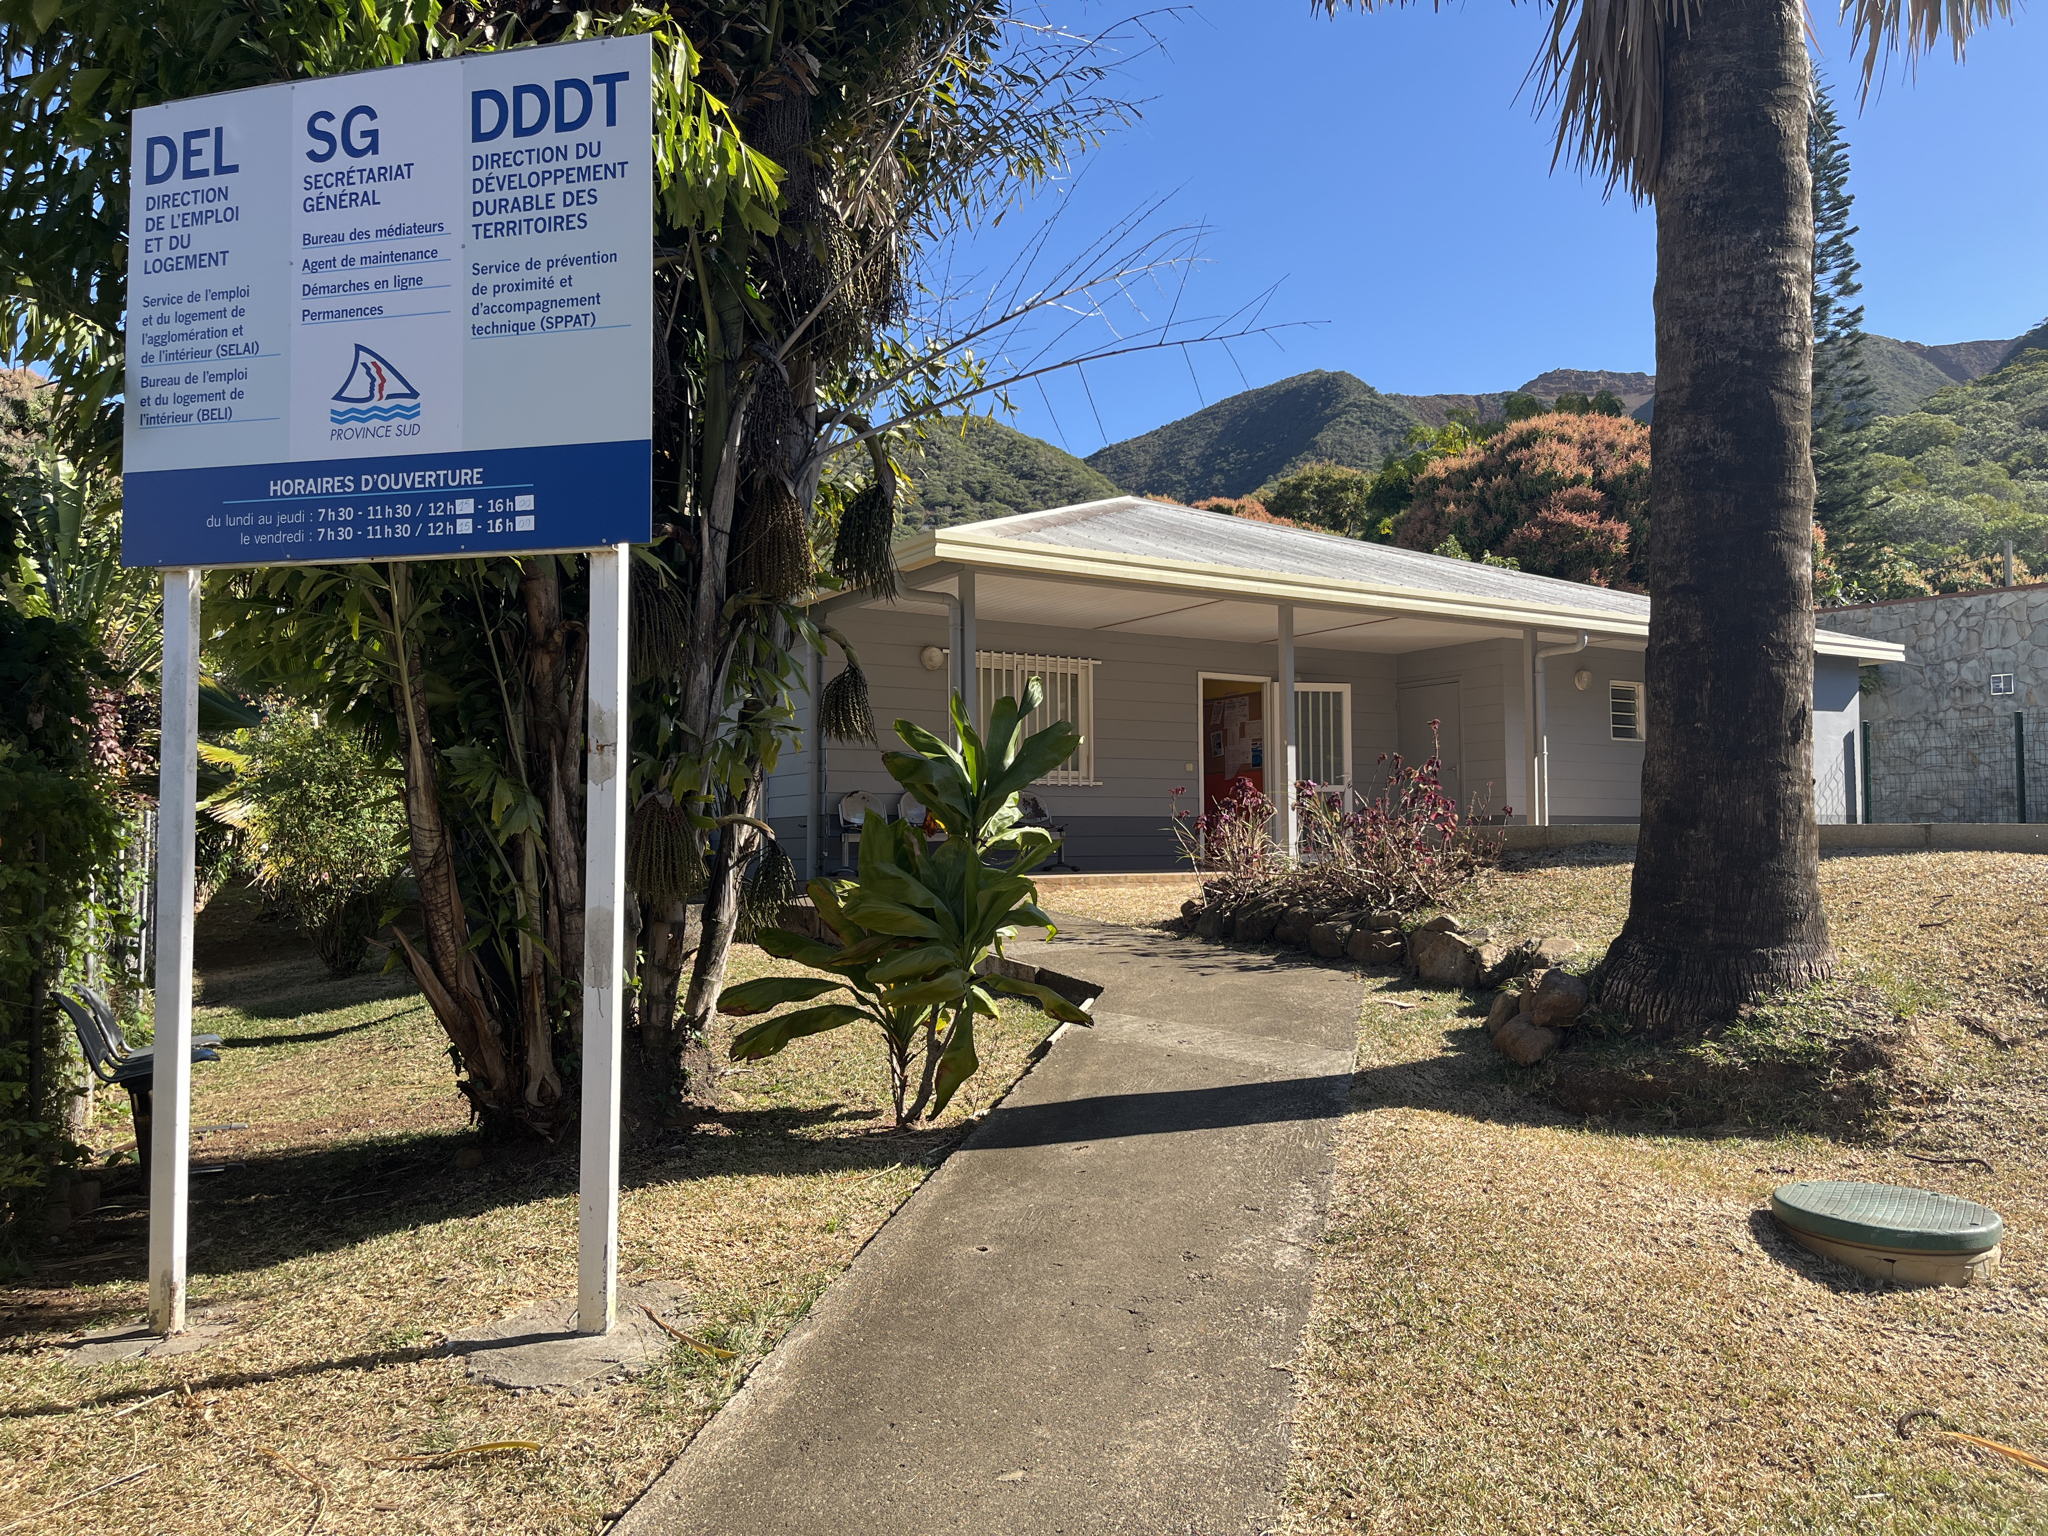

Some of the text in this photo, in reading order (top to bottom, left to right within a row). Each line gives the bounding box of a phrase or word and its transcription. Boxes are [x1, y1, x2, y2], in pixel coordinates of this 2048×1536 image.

[472, 71, 630, 143] DDDT
[305, 105, 379, 163] SG
[145, 126, 239, 185] DEL
[472, 141, 601, 171] DIRECTION DU
[303, 163, 414, 191] SECRÉTARIAT
[472, 161, 628, 194] DÉVELOPPEMENT
[146, 186, 229, 211] DIRECTION
[303, 189, 381, 213] GÉNÉRAL
[472, 188, 598, 217] DURABLE DES
[145, 216, 165, 232] DE
[303, 222, 444, 245] Bureau des médiateurs
[472, 213, 588, 240] TERRITOIRES
[145, 234, 191, 253] ET DU
[144, 251, 229, 275] LOGEMENT
[302, 249, 438, 273] Agent de maintenance
[472, 251, 617, 276] Service de prévention
[302, 275, 423, 296] Démarches en ligne
[472, 275, 573, 297] de proximité et
[142, 294, 183, 308] Service
[187, 291, 201, 303] de
[142, 305, 245, 326] et du logement de
[302, 306, 383, 321] Permanences
[472, 312, 596, 336] technique (SPPAT)
[232, 325, 243, 337] et
[141, 352, 155, 364] de
[216, 341, 259, 358] (SELAI)
[141, 376, 180, 388] Bureau
[184, 372, 199, 384] de
[140, 388, 244, 407] et du logement de
[197, 406, 233, 423] (BELI)
[330, 424, 420, 441] PROVINCE SUD
[270, 475, 354, 496] HORAIRES
[206, 515, 221, 528] du
[226, 513, 254, 526] lundi
[258, 514, 272, 525] au
[277, 510, 305, 527] jeudi
[240, 533, 250, 545] le
[254, 530, 304, 544] vendredi
